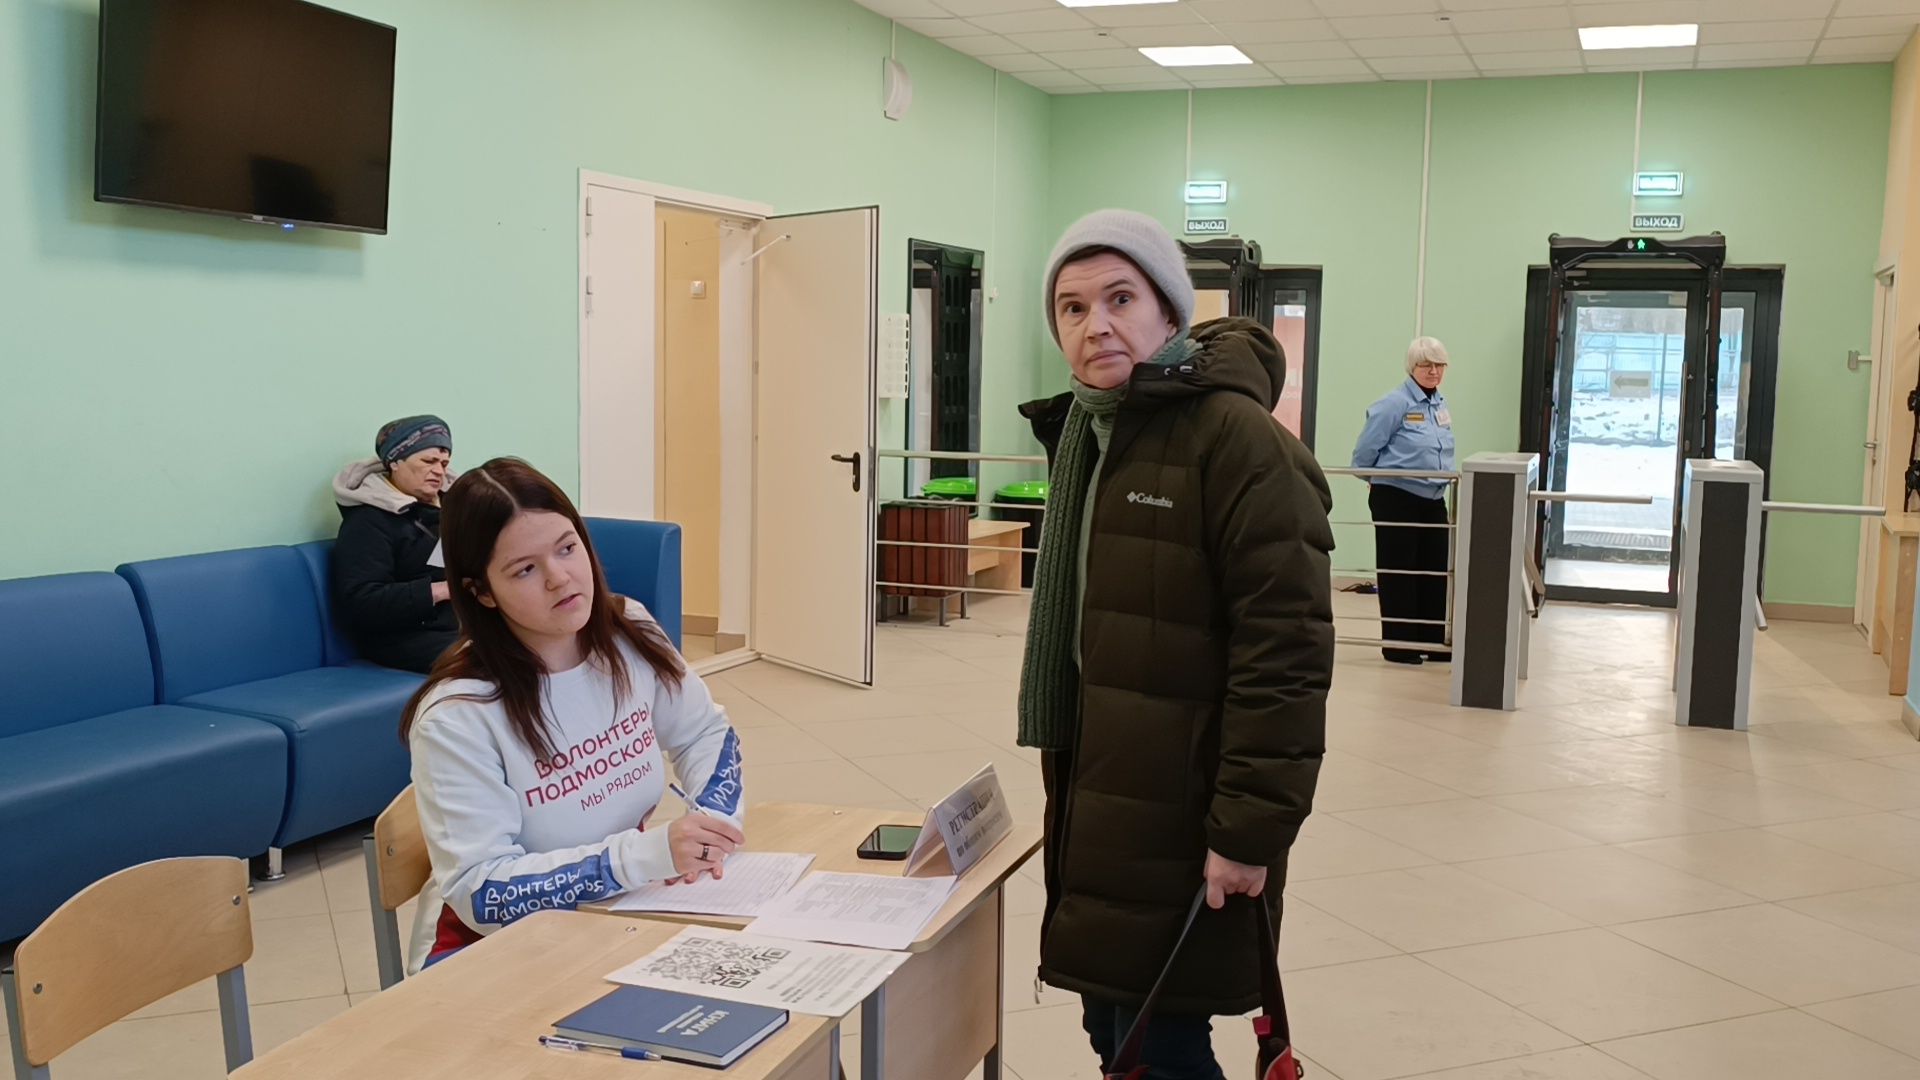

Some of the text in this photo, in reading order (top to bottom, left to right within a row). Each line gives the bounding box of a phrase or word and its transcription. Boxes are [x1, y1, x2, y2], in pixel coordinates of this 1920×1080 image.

[1188, 220, 1226, 230] ВЫХОД
[1634, 217, 1679, 227] ВЫХОД
[1136, 492, 1173, 508] Columbia
[534, 702, 650, 779] ВОЛОНТЕРЫ
[580, 761, 653, 811] МЫ РЯДОМ
